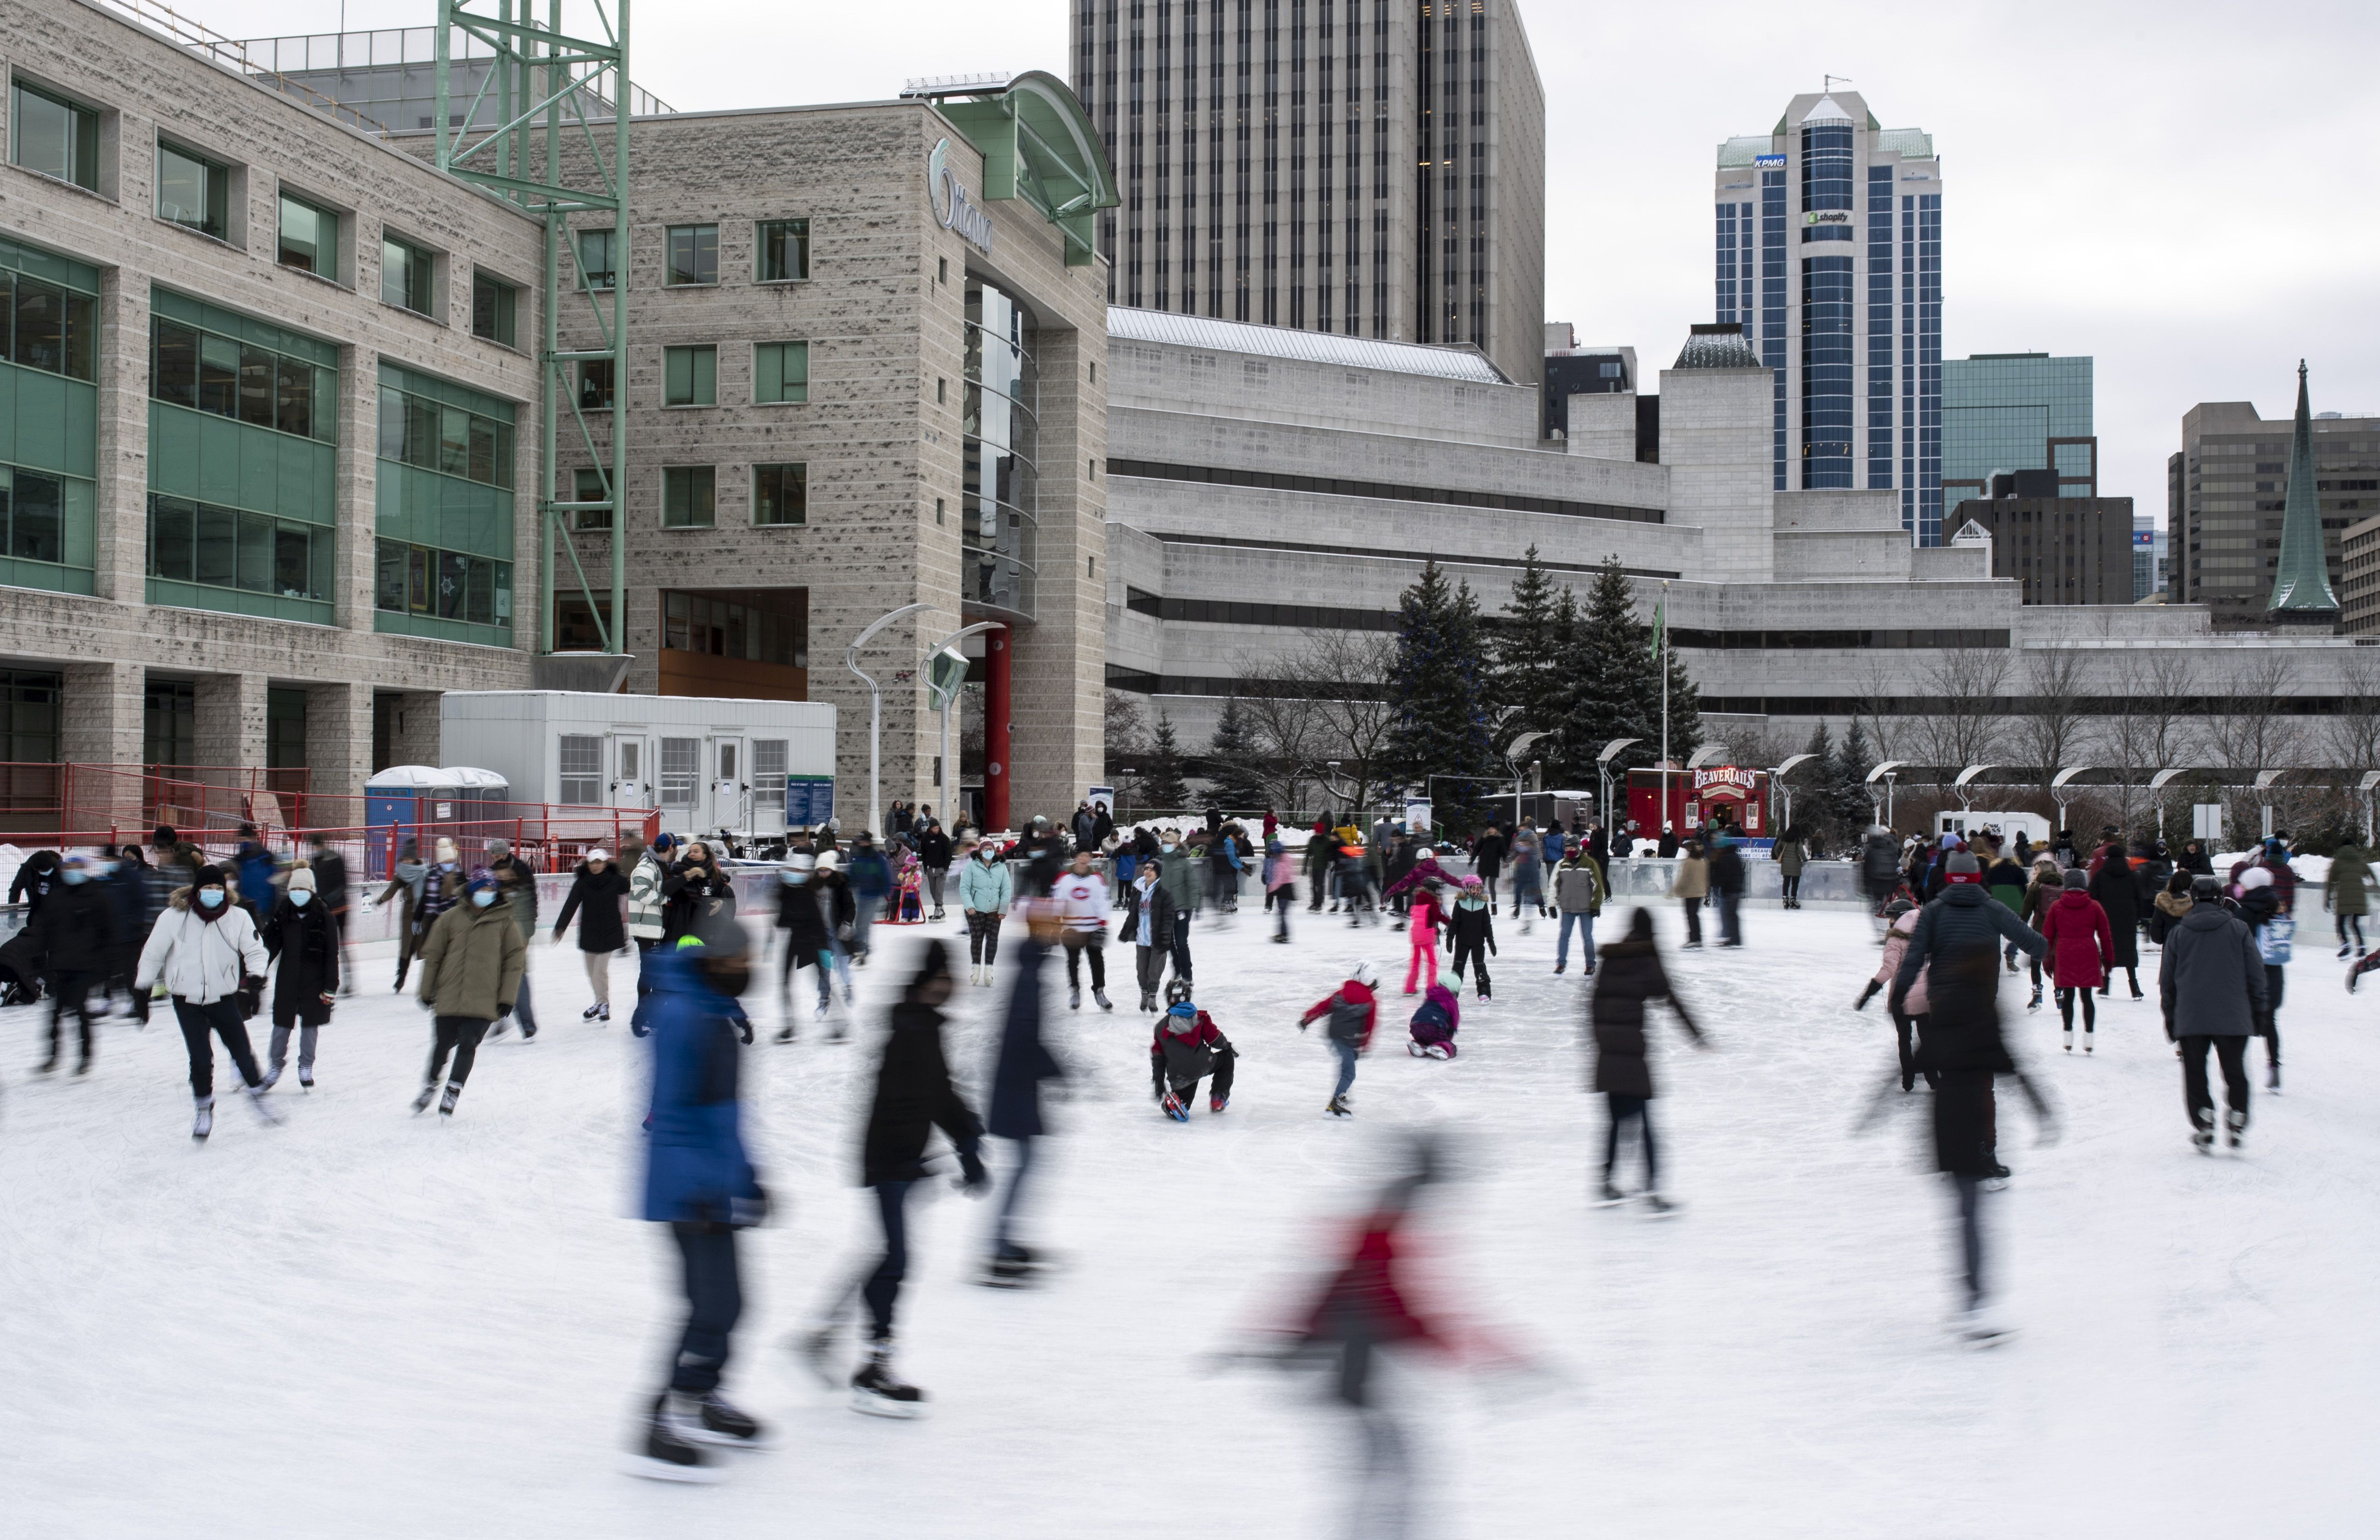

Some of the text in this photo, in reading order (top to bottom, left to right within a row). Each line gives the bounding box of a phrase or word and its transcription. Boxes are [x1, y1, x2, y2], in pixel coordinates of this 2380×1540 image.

[1754, 159, 1785, 168] KPMG
[933, 161, 993, 254] Ottawa
[1819, 213, 1848, 223] shopify
